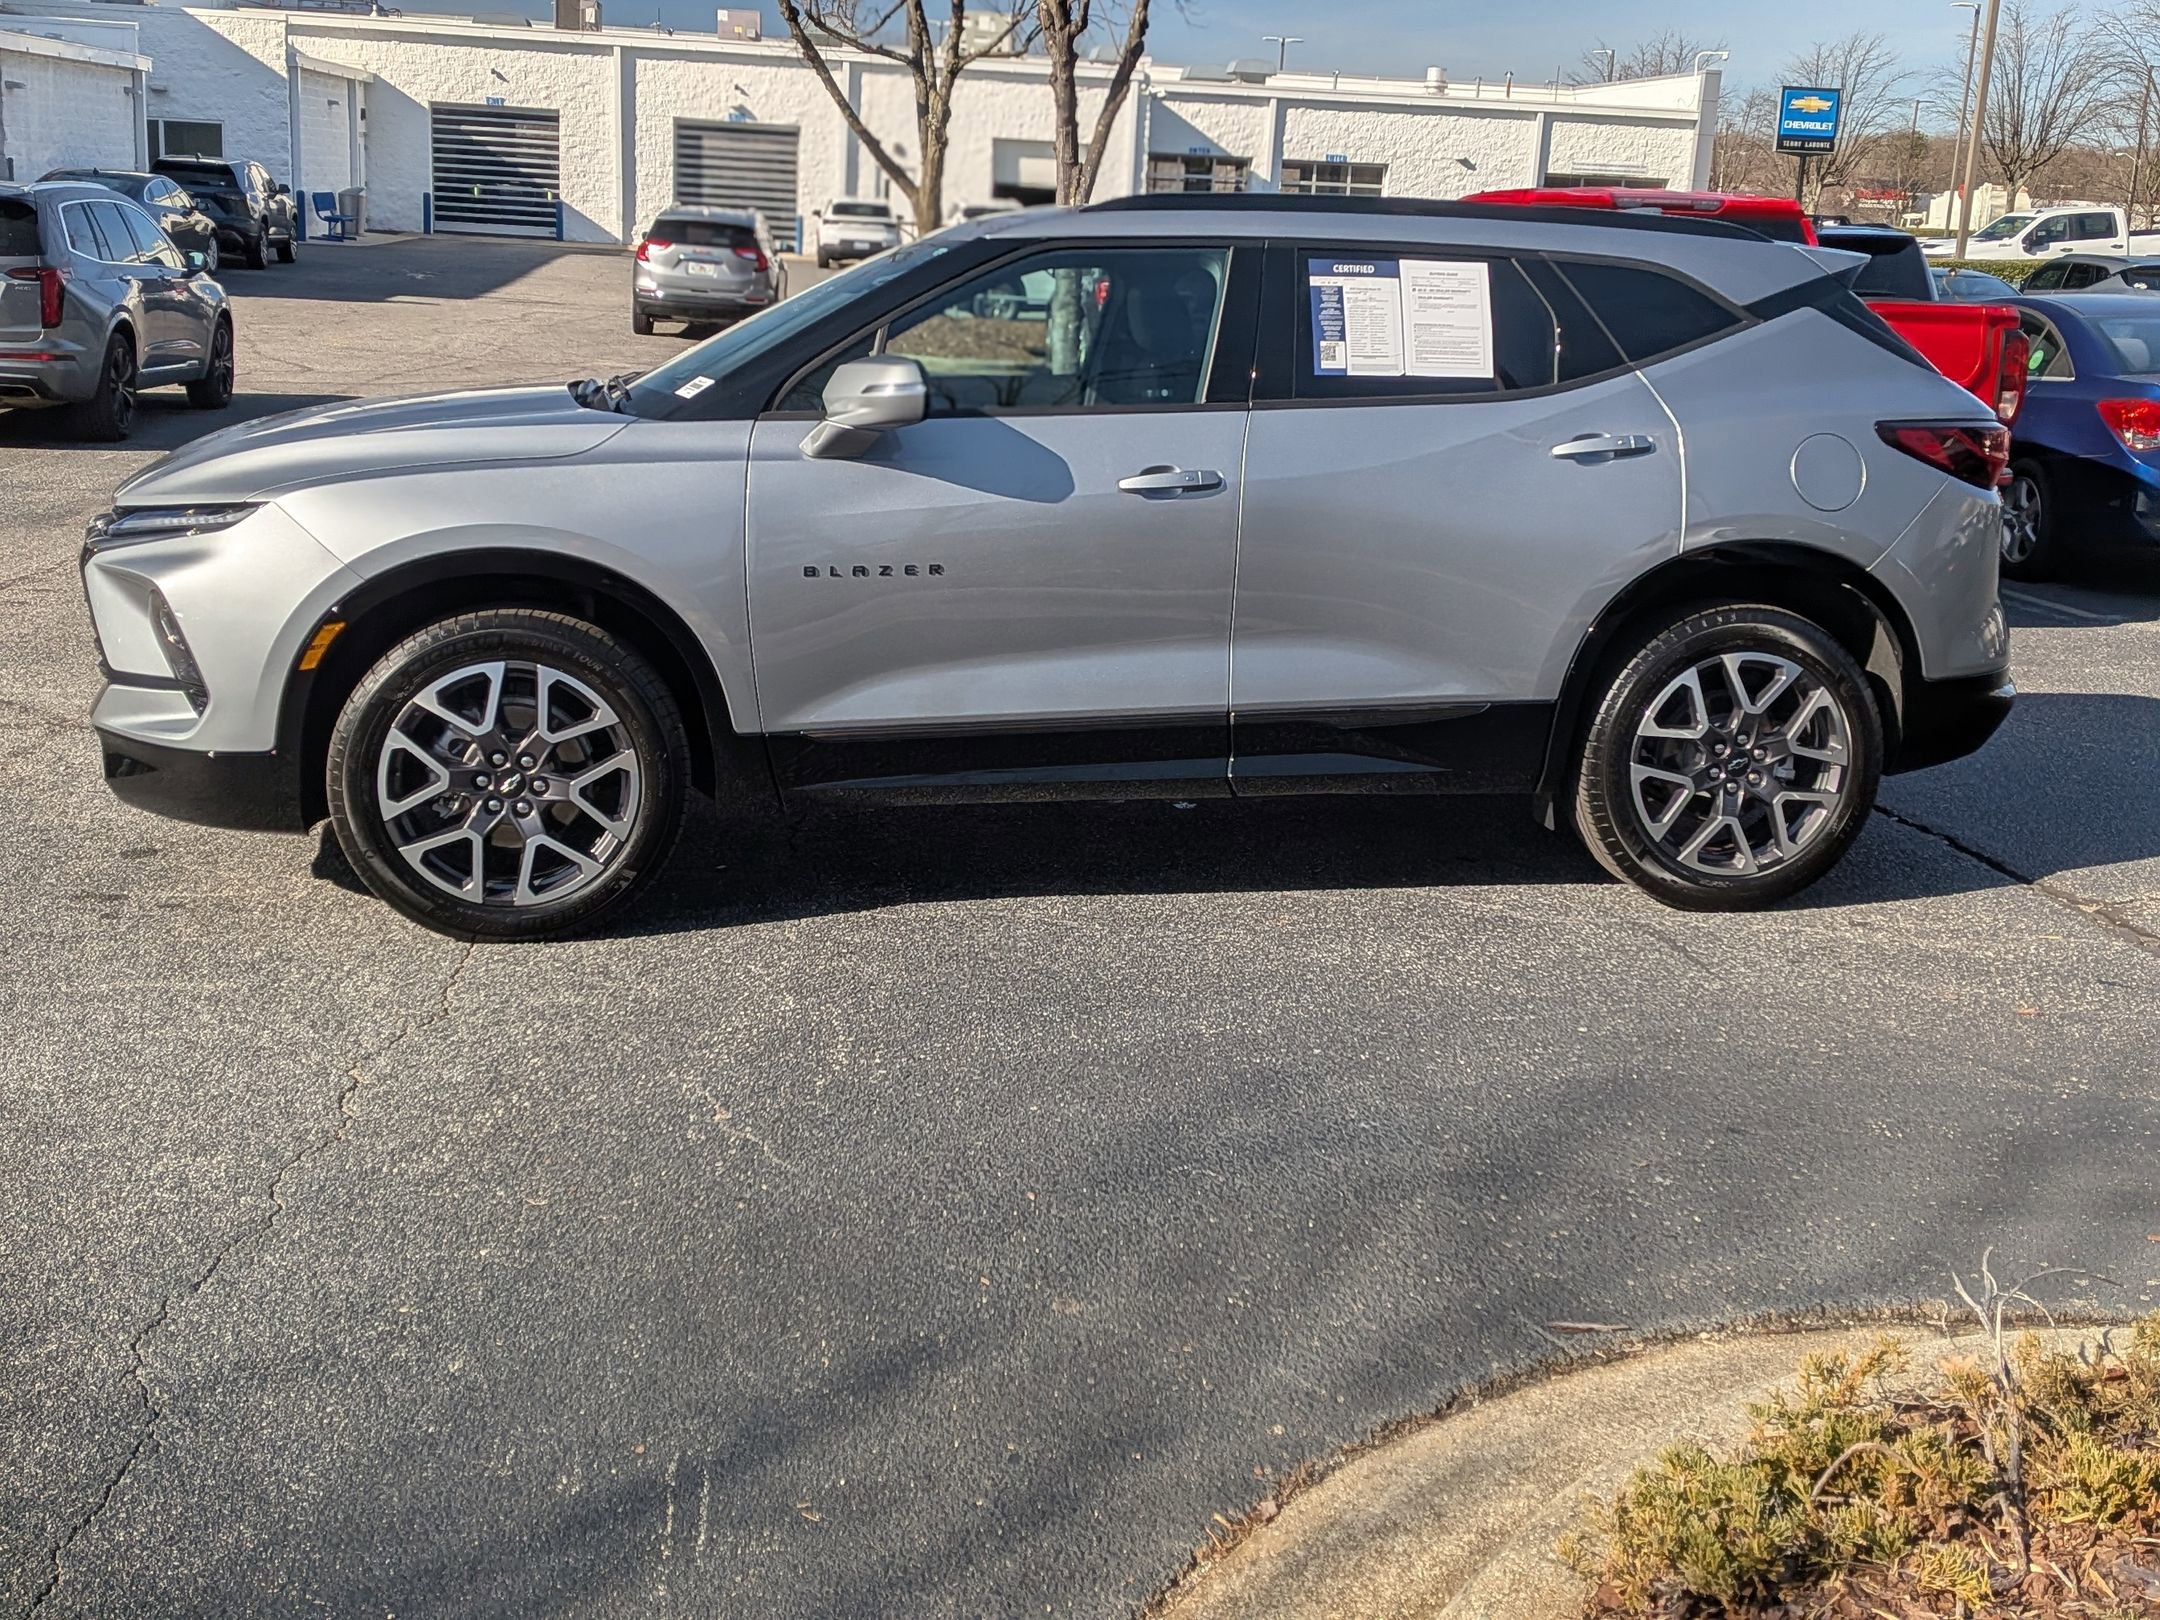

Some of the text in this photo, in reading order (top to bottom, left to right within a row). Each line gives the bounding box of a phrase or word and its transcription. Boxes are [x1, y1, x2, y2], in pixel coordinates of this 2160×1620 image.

[1784, 120, 1834, 131] CHEVROLET
[1332, 264, 1375, 274] CERTIFIED
[803, 563, 945, 578] BLAZER
